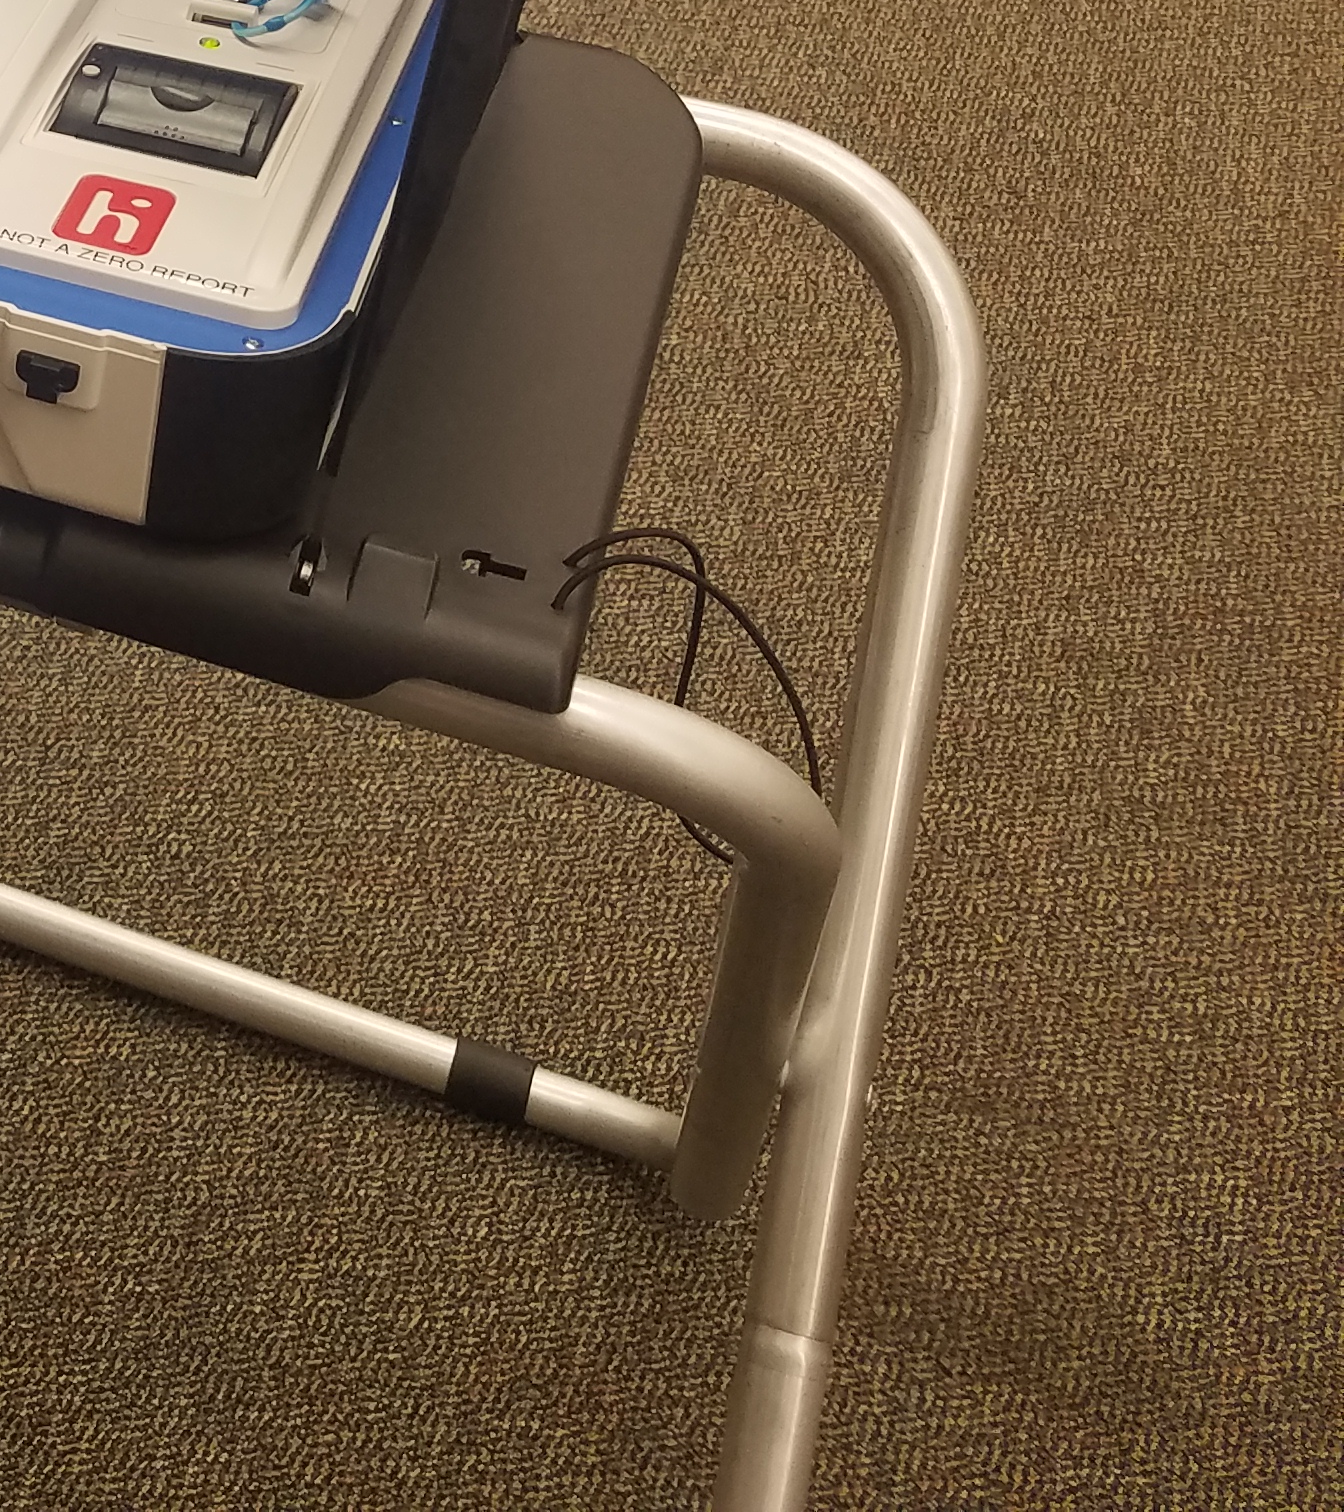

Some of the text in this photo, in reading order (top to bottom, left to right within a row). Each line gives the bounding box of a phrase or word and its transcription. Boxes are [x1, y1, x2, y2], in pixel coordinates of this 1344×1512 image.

[0, 228, 53, 249] NOT
[54, 243, 71, 255] A
[76, 248, 144, 273] ZERO
[151, 265, 255, 299] REPORT
